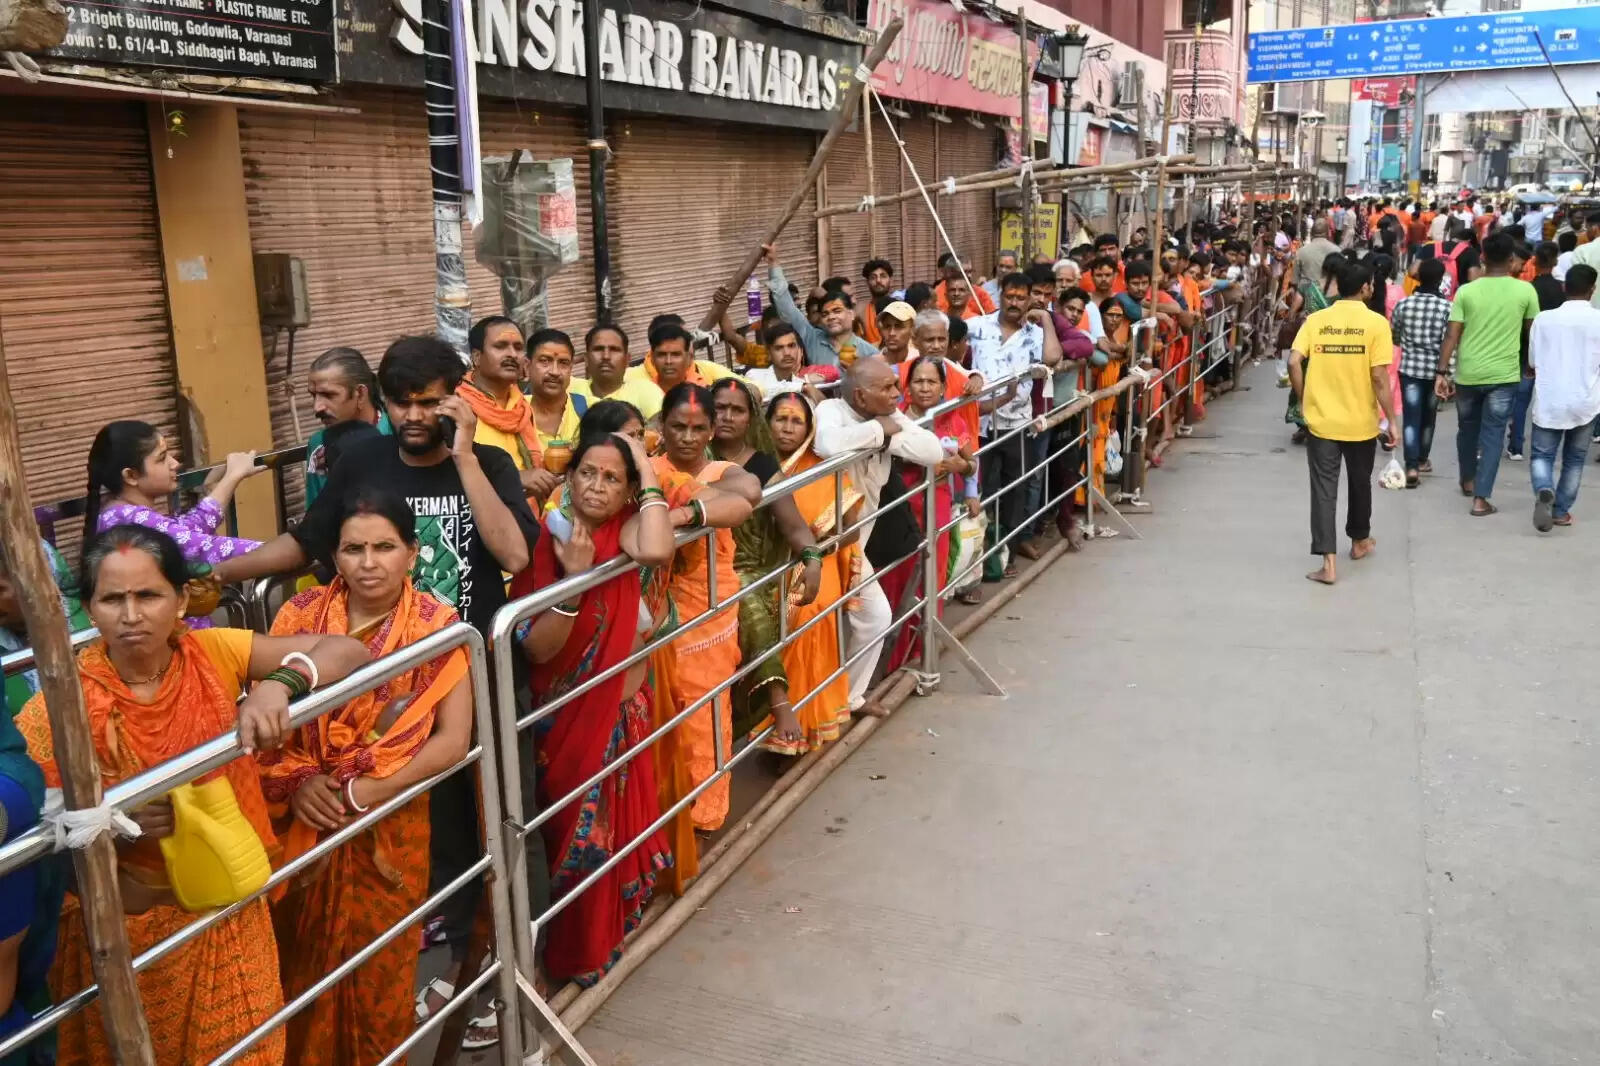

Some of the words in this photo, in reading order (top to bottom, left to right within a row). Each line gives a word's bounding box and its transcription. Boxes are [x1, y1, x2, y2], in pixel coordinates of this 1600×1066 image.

[80, 7, 122, 29] Bright
[125, 13, 183, 36] Building,
[186, 20, 242, 42] Godowlia,
[245, 27, 292, 46] Varanasi
[215, 0, 254, 17] PLASTIC
[256, 5, 288, 21] FRAME
[291, 10, 311, 25] ETC.
[63, 33, 95, 48] own
[107, 34, 122, 51] D.
[177, 40, 236, 62] Siddhagiri
[239, 47, 270, 66] Bagh,
[272, 51, 317, 69] Varanasi
[390, 0, 684, 91] NSKARR
[689, 28, 838, 112] BANARAS
